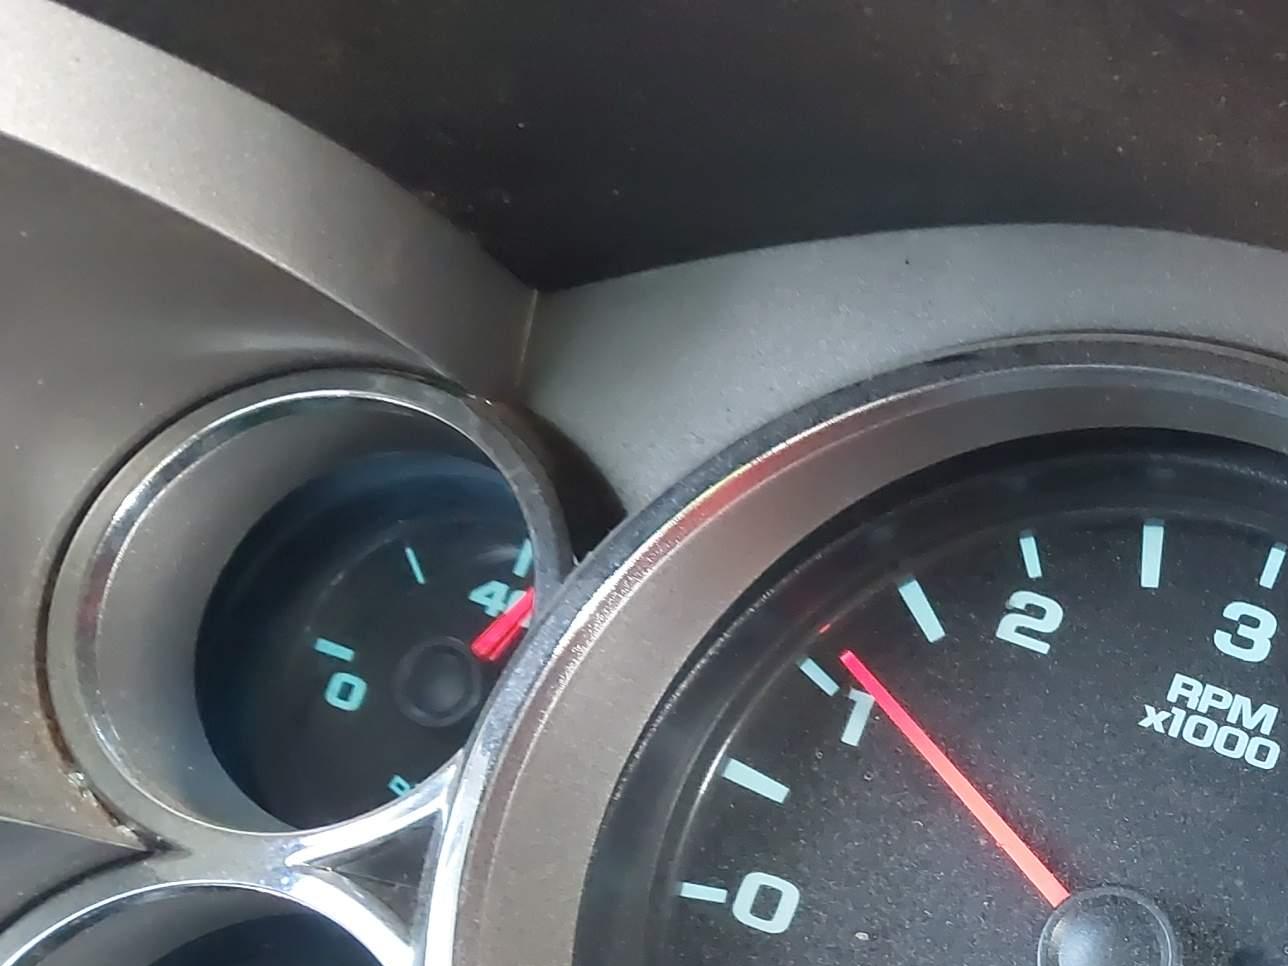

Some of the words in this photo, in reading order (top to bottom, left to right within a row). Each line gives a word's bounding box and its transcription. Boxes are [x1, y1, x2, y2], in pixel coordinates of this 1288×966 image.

[997, 590, 1063, 654] 2
[1212, 601, 1278, 663] 3
[325, 673, 366, 710] 0
[842, 689, 874, 746] 1
[1167, 673, 1279, 736] RPM
[1138, 705, 1280, 769] x1000
[732, 871, 800, 934] 0
